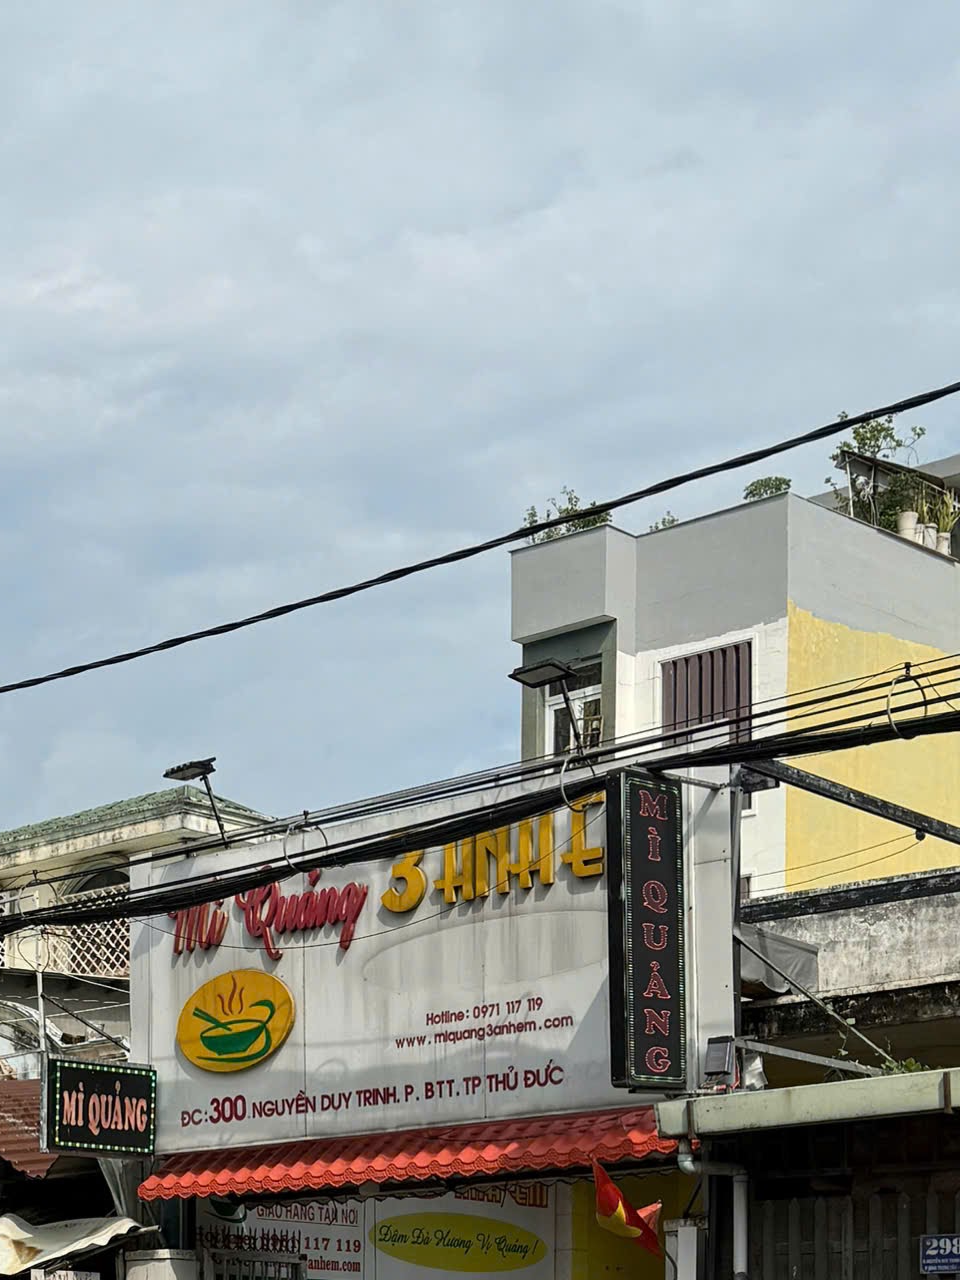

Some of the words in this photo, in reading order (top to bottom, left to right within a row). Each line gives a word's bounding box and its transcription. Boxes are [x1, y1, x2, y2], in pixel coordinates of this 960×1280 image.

[380, 850, 427, 914] 3
[426, 1008, 470, 1026] Hotline:
[472, 1003, 500, 1019] 0971
[506, 999, 523, 1015] 117
[527, 997, 543, 1012] 119
[320, 1091, 352, 1113] DUY
[463, 1076, 481, 1095] TP
[486, 1065, 518, 1093] THỦ
[523, 1059, 565, 1089] ĐỨC
[62, 1081, 85, 1127] MÌ
[88, 1080, 148, 1136] QUẢNG
[256, 1204, 283, 1218] GIAO
[304, 1236, 330, 1251] 117
[336, 1238, 361, 1253] 119
[378, 1225, 409, 1246] Đậm
[411, 1227, 432, 1245] Đà
